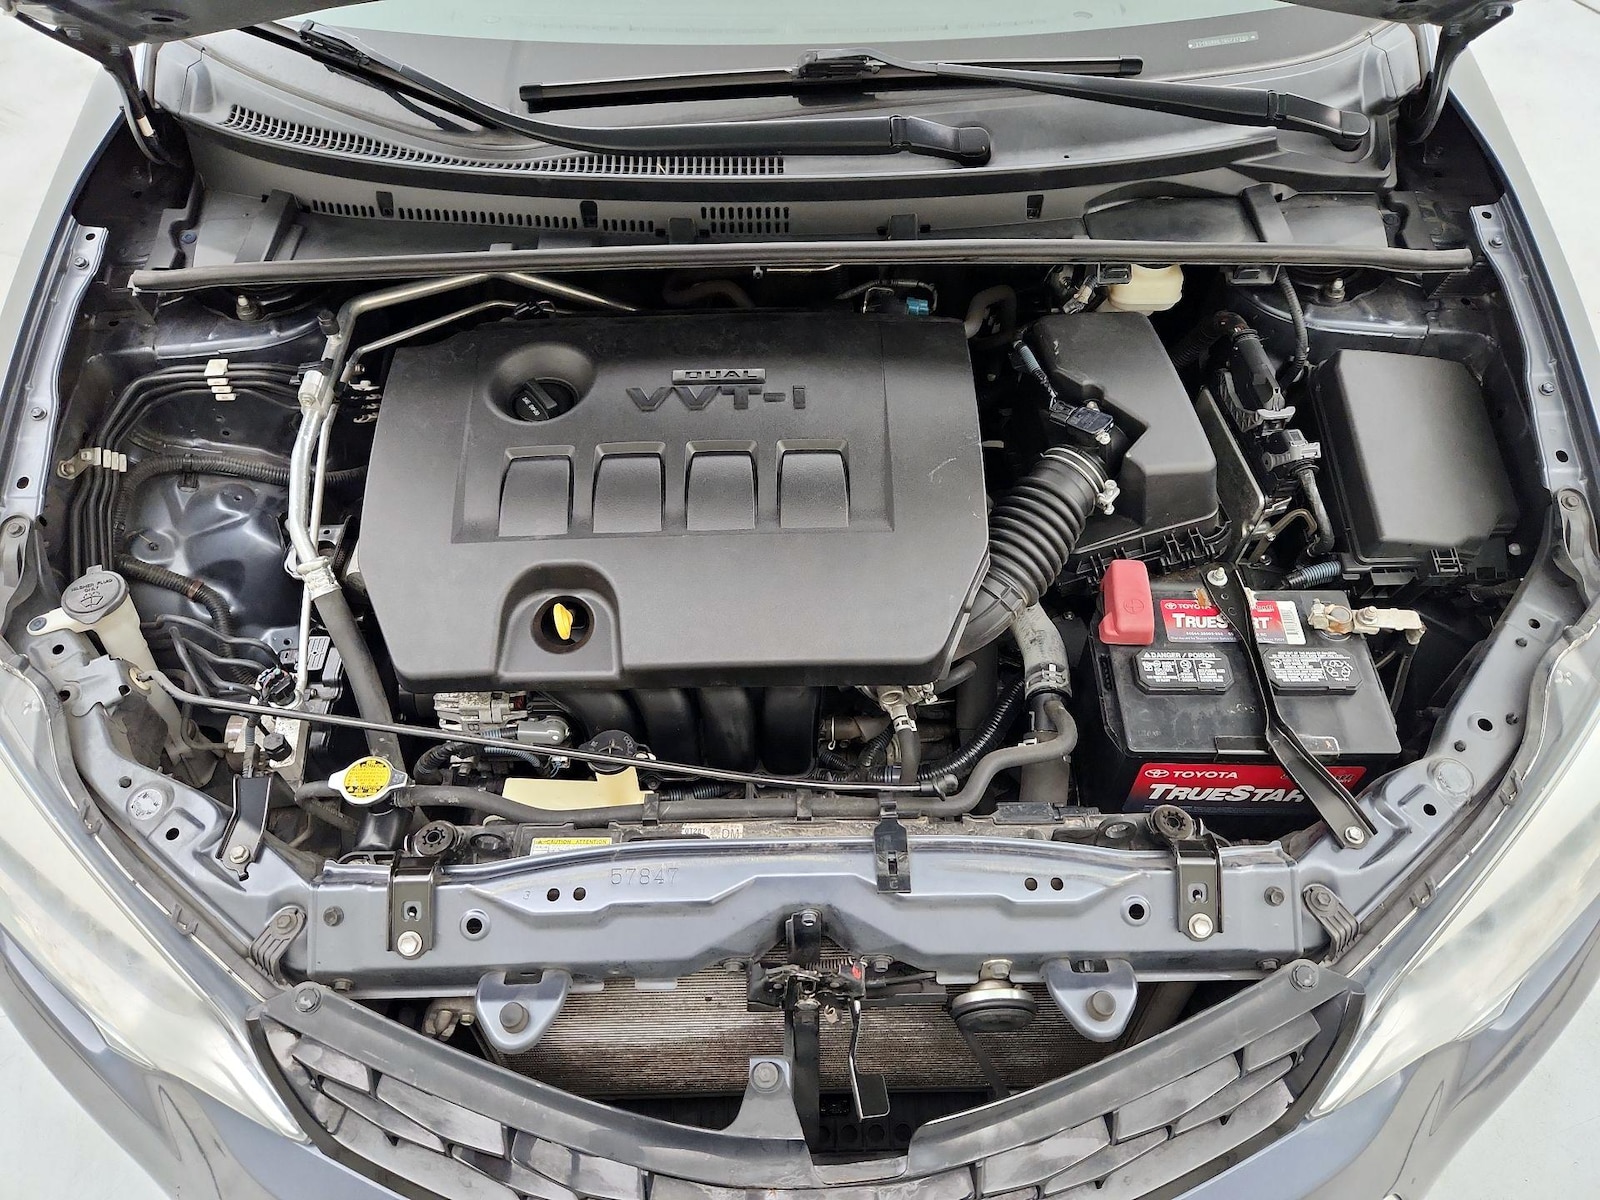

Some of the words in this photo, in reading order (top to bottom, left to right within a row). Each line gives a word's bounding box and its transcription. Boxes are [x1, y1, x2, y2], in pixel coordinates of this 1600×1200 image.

[684, 369, 760, 379] DUAL
[1173, 770, 1238, 779] TOYOTA
[610, 867, 680, 886] 57847
